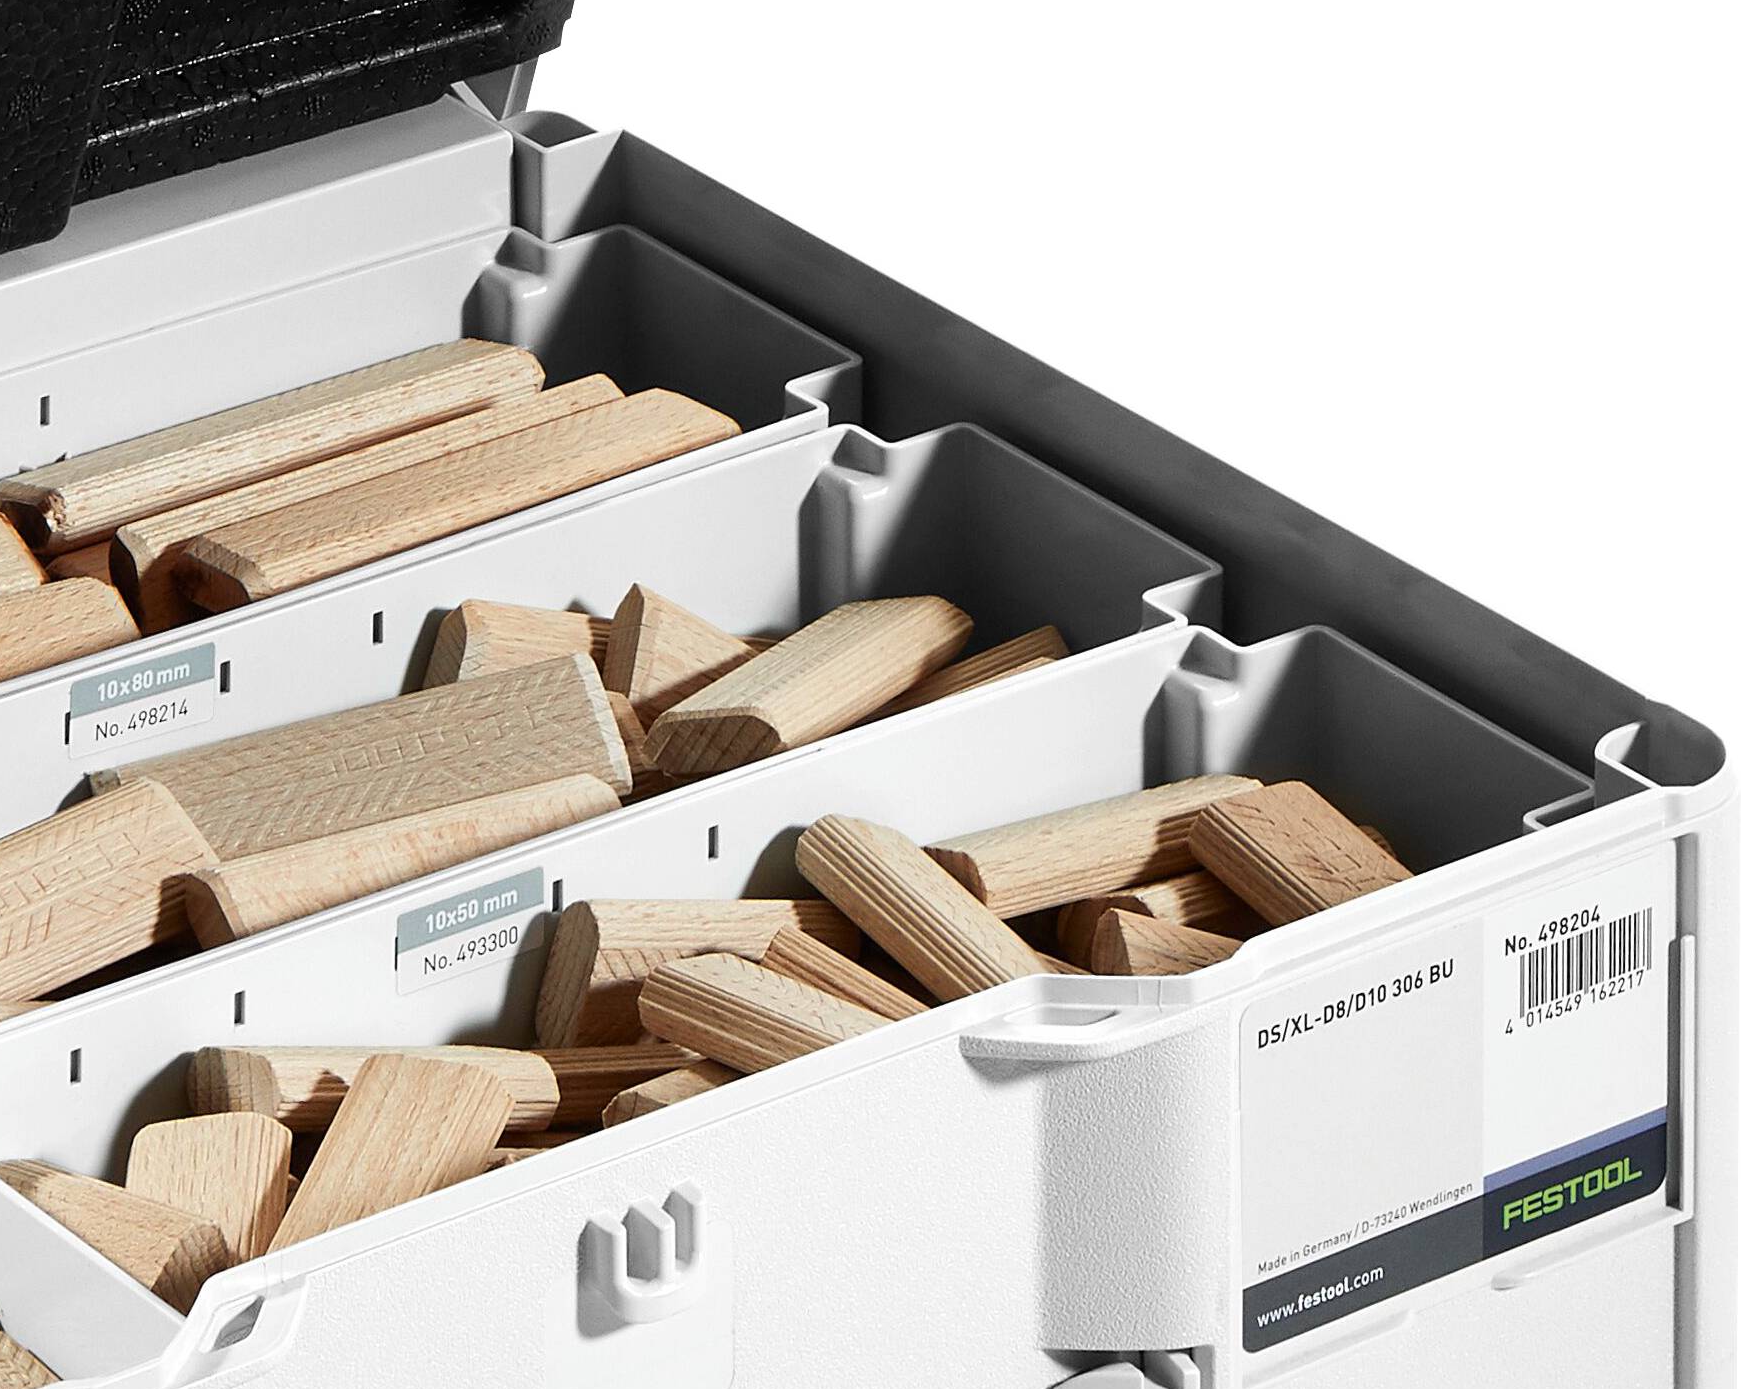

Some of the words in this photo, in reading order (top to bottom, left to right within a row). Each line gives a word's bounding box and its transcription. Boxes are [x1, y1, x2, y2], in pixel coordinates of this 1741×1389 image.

[97, 670, 153, 702] 10x80
[157, 663, 190, 685] mm
[95, 721, 123, 741] No.
[128, 699, 188, 730] 498214
[425, 899, 479, 934] 10x50
[483, 889, 518, 914] mm
[1505, 935, 1533, 956] No.
[1538, 905, 1600, 942] 498204
[424, 953, 453, 975] No.
[456, 925, 519, 962] 493300
[1258, 983, 1387, 1049] DS/XL-D8/D10
[1392, 969, 1424, 998] 306
[1429, 958, 1454, 984] BU
[1526, 994, 1582, 1028] 014549
[1590, 970, 1644, 1003] 162217
[1502, 1157, 1643, 1230] FESTOOL
[1258, 1255, 1287, 1275] Made
[1290, 1251, 1300, 1263] in
[1303, 1230, 1352, 1258] Germany
[1361, 1206, 1407, 1234] D-73240
[1409, 1182, 1473, 1215] Wendlingen
[1257, 1265, 1384, 1328] www.festool.com
